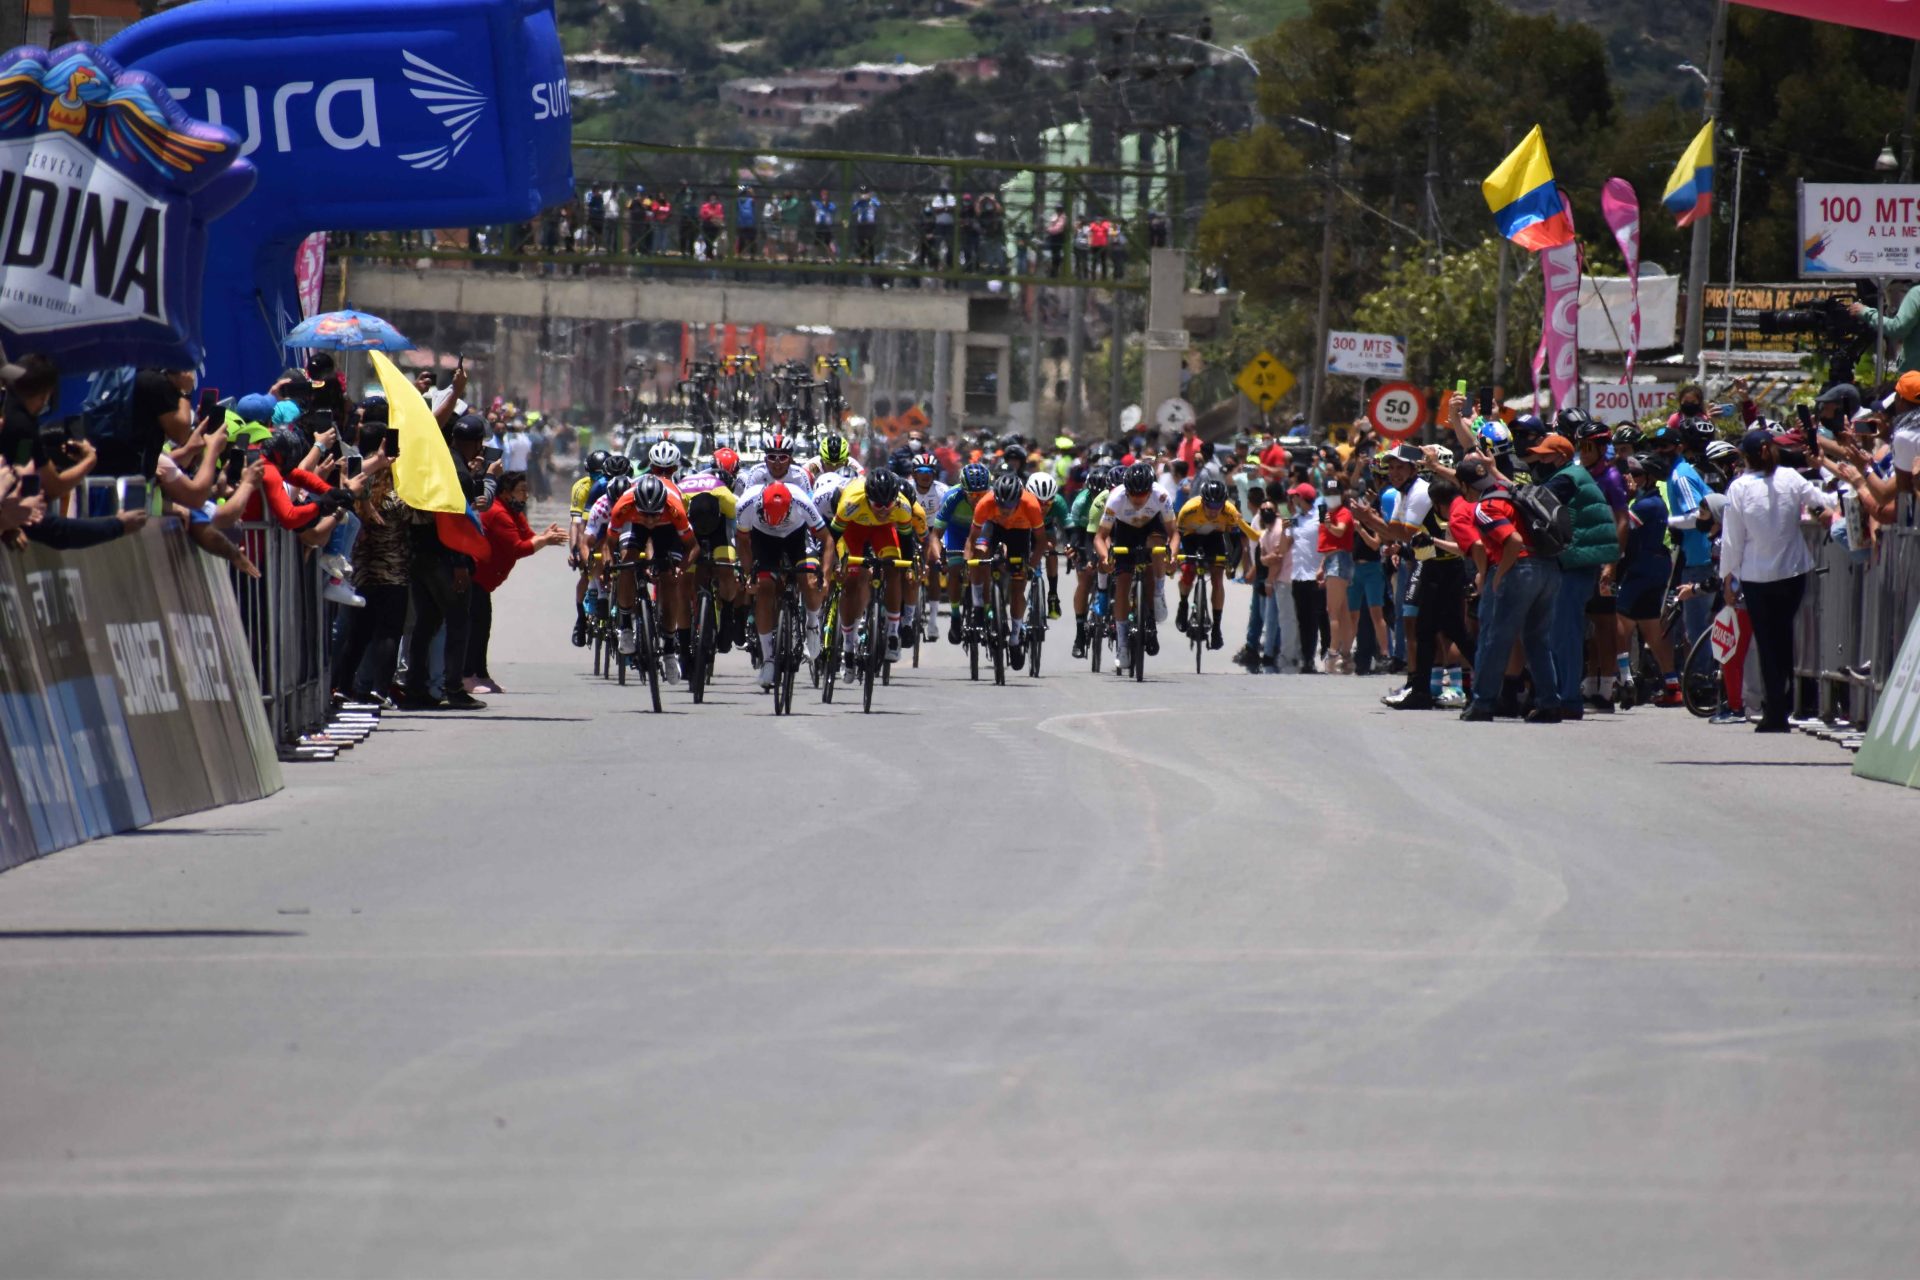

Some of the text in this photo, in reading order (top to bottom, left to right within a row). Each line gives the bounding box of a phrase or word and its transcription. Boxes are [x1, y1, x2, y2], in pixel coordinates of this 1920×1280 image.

[167, 78, 380, 157] ura
[28, 151, 83, 180] CERVEZA
[1820, 196, 1920, 223] 100 MT
[1868, 225, 1920, 237] A LA ME
[1333, 337, 1393, 354] 300 MTS
[1384, 398, 1411, 416] 50
[1595, 392, 1630, 409] 200
